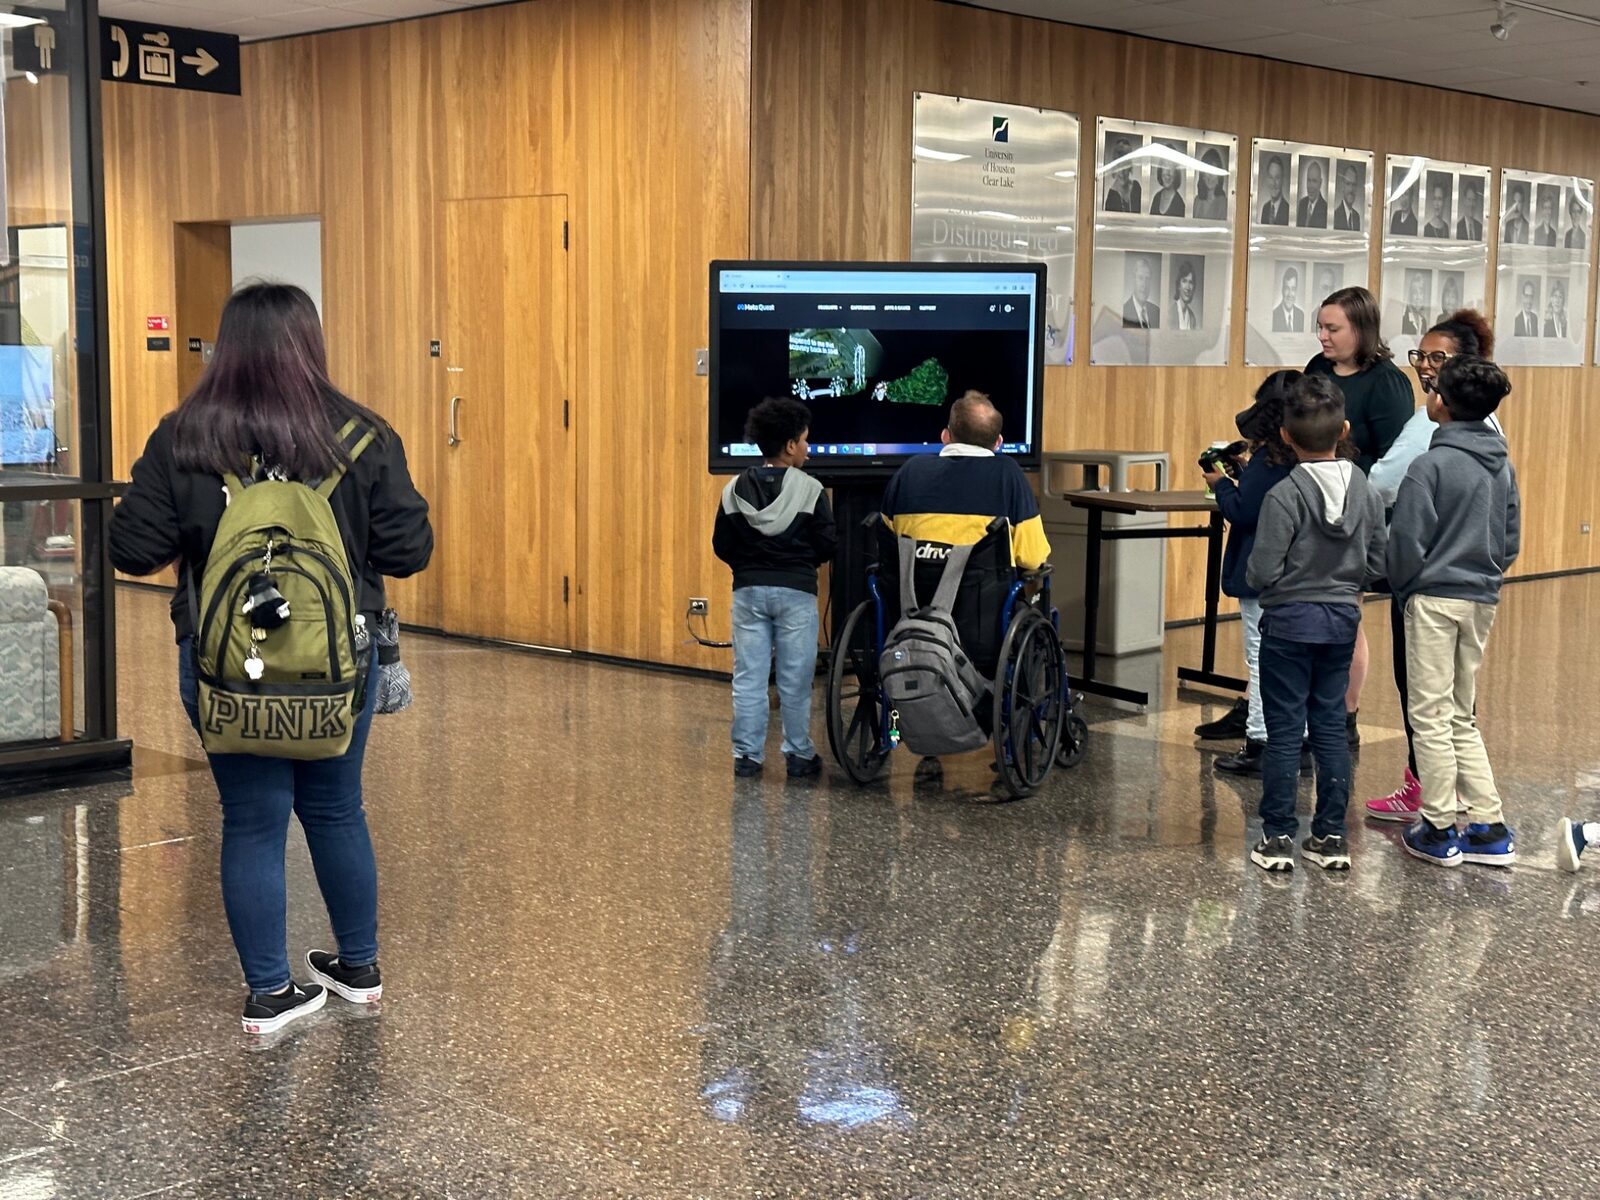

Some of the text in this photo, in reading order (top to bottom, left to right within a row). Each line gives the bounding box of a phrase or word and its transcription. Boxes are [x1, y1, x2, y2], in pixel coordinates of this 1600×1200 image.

[984, 147, 1015, 163] University
[982, 161, 1016, 174] of Houston
[982, 175, 1015, 188] Clear Lake
[932, 218, 1059, 256] Distinguished
[758, 303, 775, 312] Quest
[916, 543, 952, 559] driv
[206, 689, 347, 740] PINK
